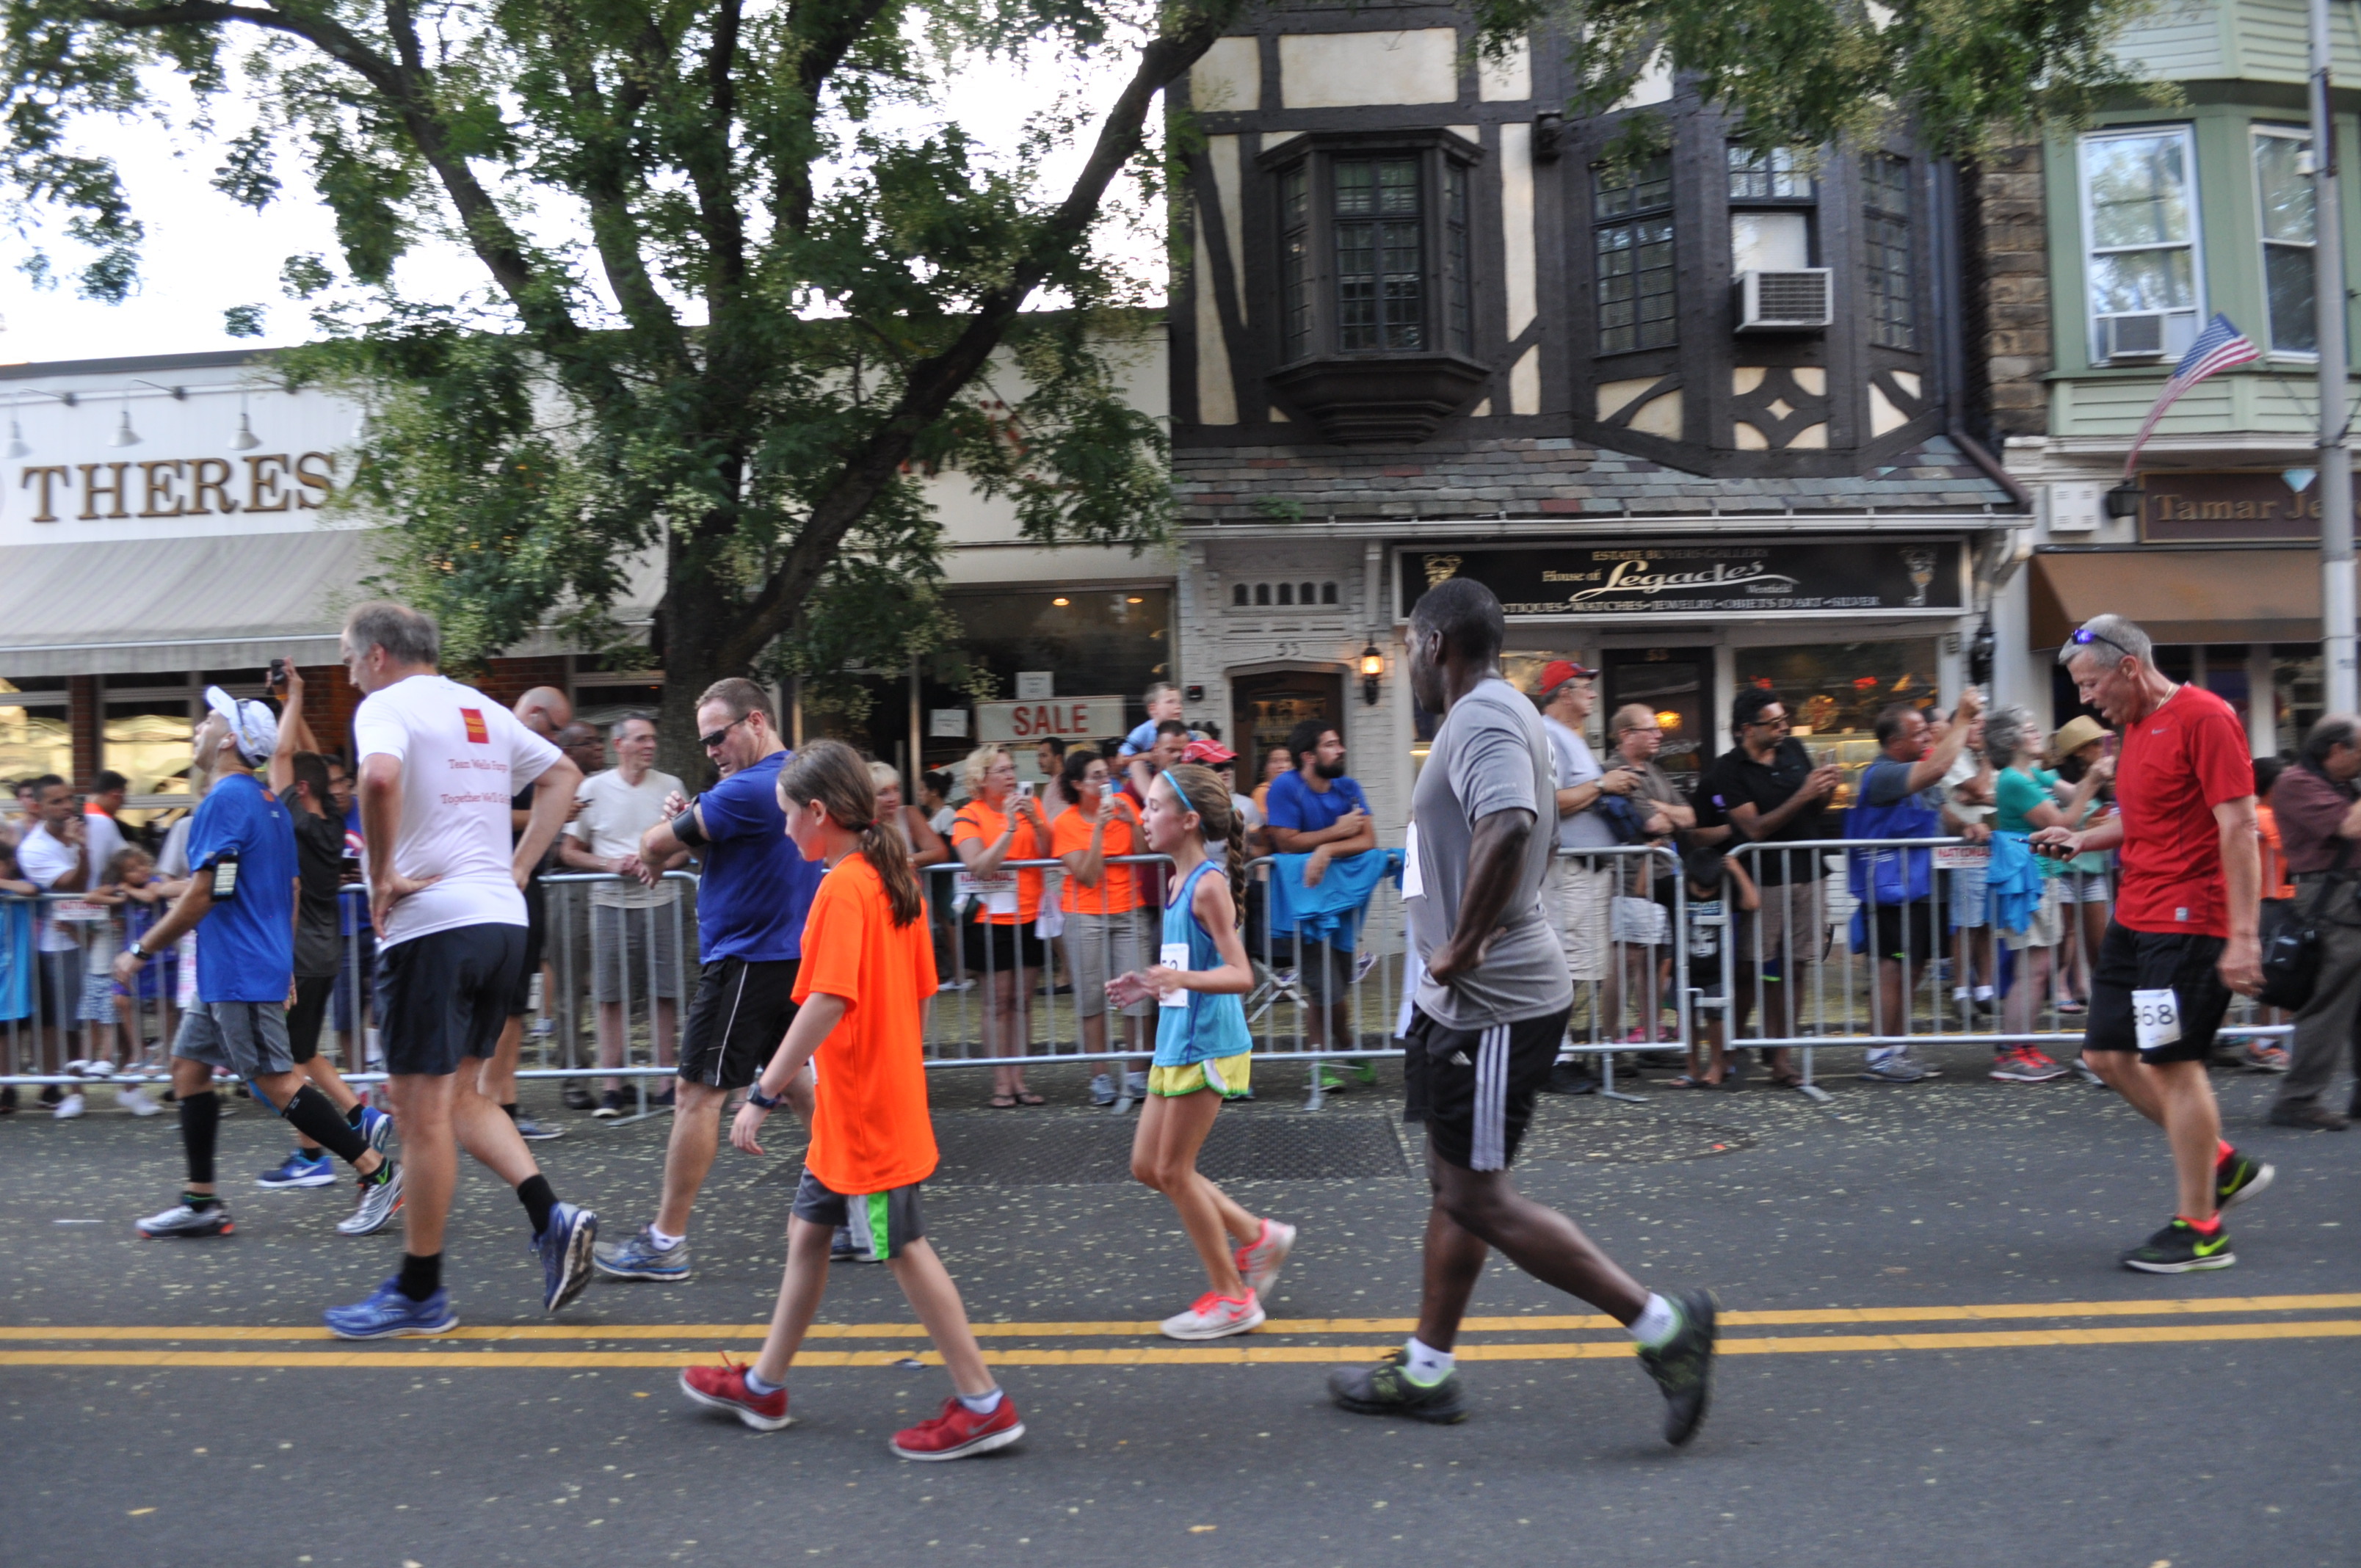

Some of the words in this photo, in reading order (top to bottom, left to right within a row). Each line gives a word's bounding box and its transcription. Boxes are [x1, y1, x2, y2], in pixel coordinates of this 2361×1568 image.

[21, 449, 373, 523] THERES
[2154, 494, 2279, 520] Tamar
[1012, 704, 1089, 736] SALE
[448, 758, 471, 769] Team
[440, 791, 482, 805] Together
